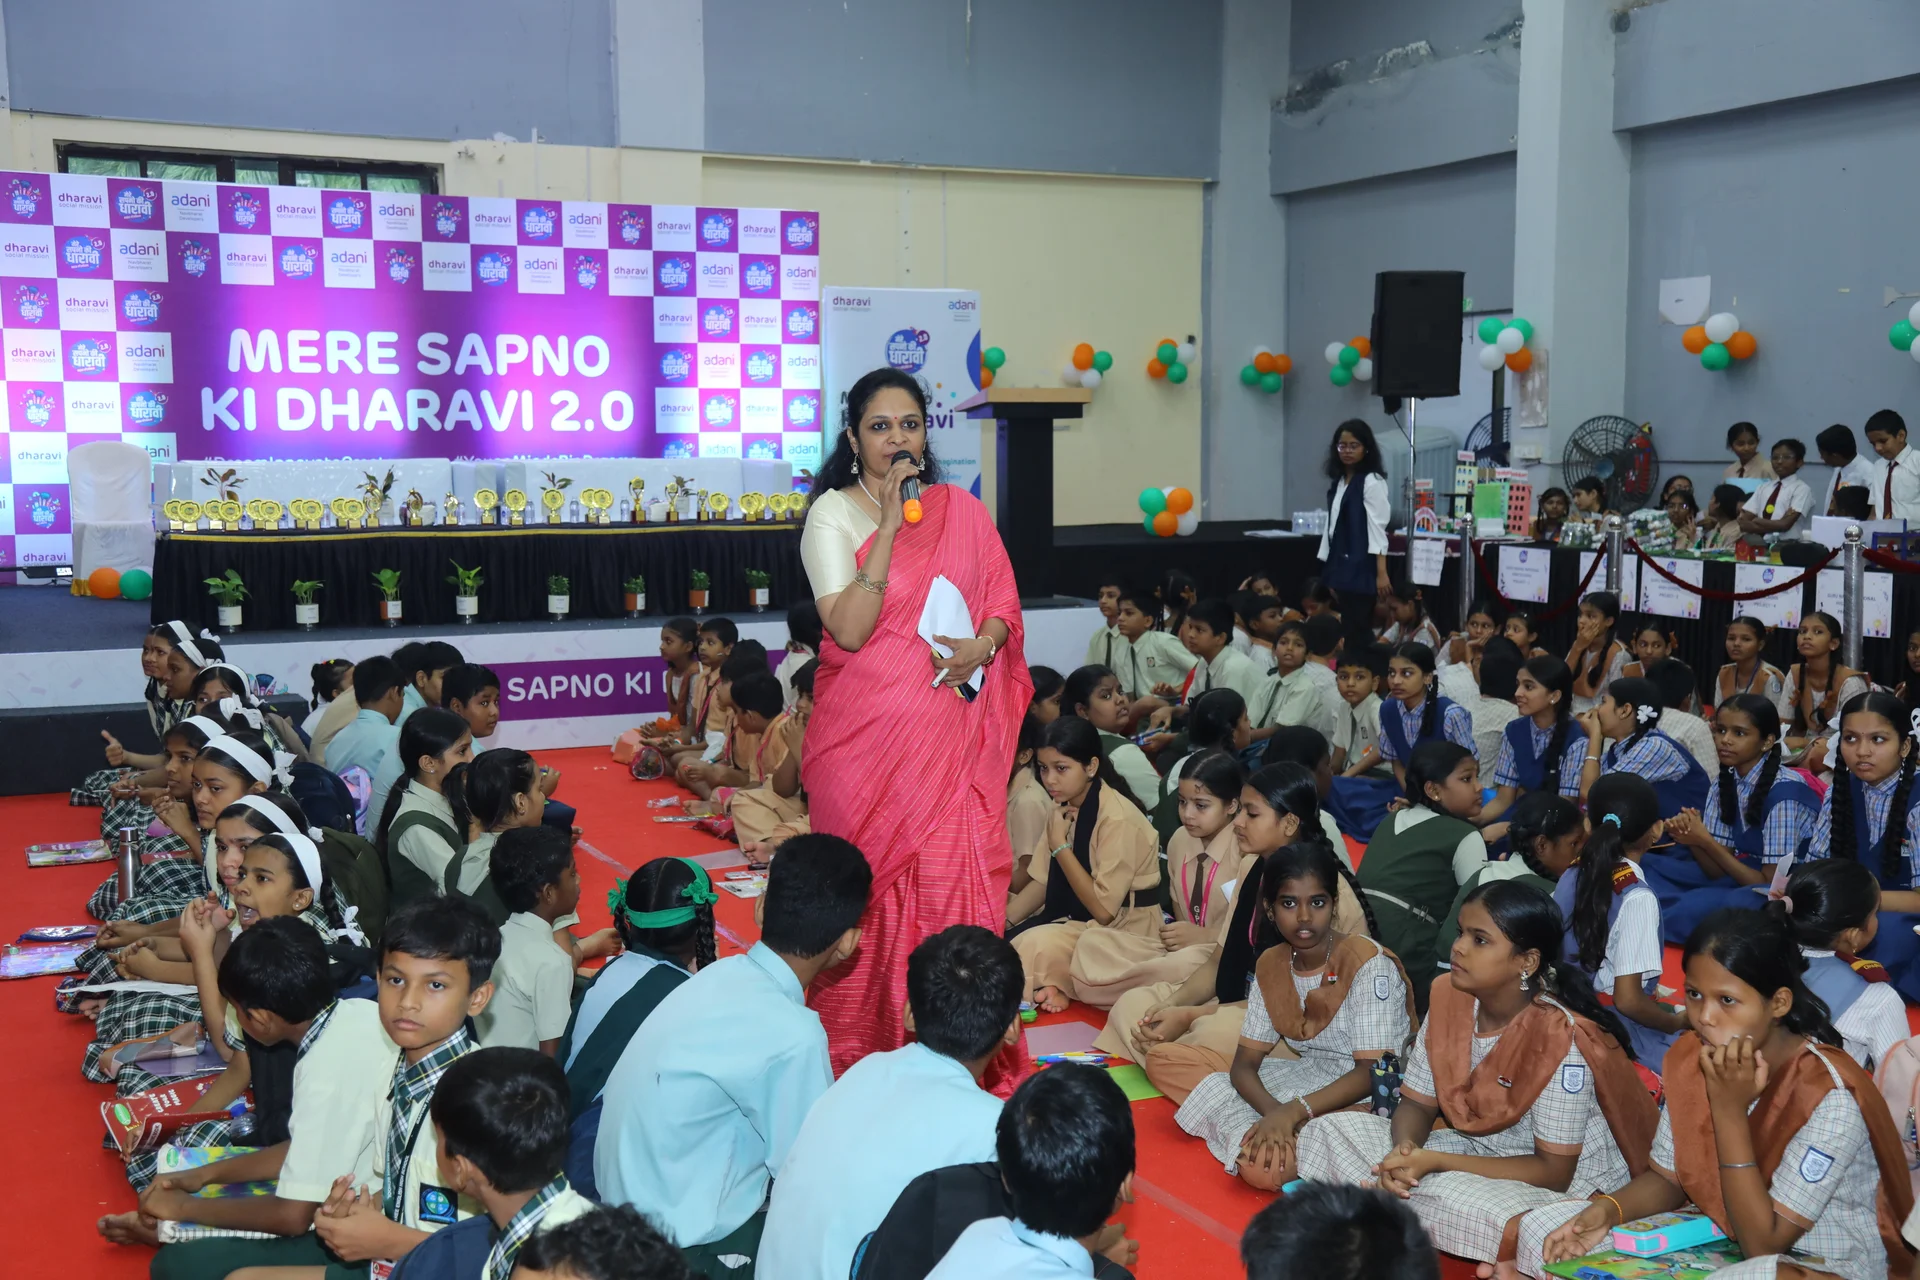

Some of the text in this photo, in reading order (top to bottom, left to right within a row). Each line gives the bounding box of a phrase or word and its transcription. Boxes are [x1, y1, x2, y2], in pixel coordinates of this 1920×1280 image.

[58, 192, 102, 203] dharavi
[170, 192, 210, 207] adani
[276, 204, 316, 214] dharavi
[378, 203, 414, 217] adani
[475, 213, 511, 222] dharavi
[568, 212, 601, 225] adani
[657, 221, 691, 230] dharavi
[743, 224, 775, 233] dharavi
[4, 242, 49, 252] dharavi
[119, 241, 159, 256] adani
[226, 252, 267, 261] dharavi
[330, 250, 367, 264] adani
[428, 259, 465, 268] dharavi
[524, 257, 557, 270] adani
[702, 263, 733, 275] adani
[614, 266, 648, 274] dharavi
[786, 266, 816, 278] adani
[65, 297, 109, 307] dharavi
[832, 296, 871, 307] dharavi
[948, 300, 976, 310] adani
[659, 313, 692, 321] dharavi
[744, 315, 776, 323] dharavi
[11, 348, 55, 357] dharavi
[125, 344, 164, 357] adani
[228, 328, 610, 378] MERE SAPNO
[704, 354, 734, 365] adani
[787, 355, 816, 366] adani
[71, 400, 114, 408] dharavi
[202, 387, 634, 432] KI DHARAVI 2.0
[788, 443, 817, 454] adani
[18, 451, 62, 459] dharavi
[24, 552, 67, 561] dharavi
[507, 672, 614, 702] SAPNO
[625, 671, 651, 696] KI
